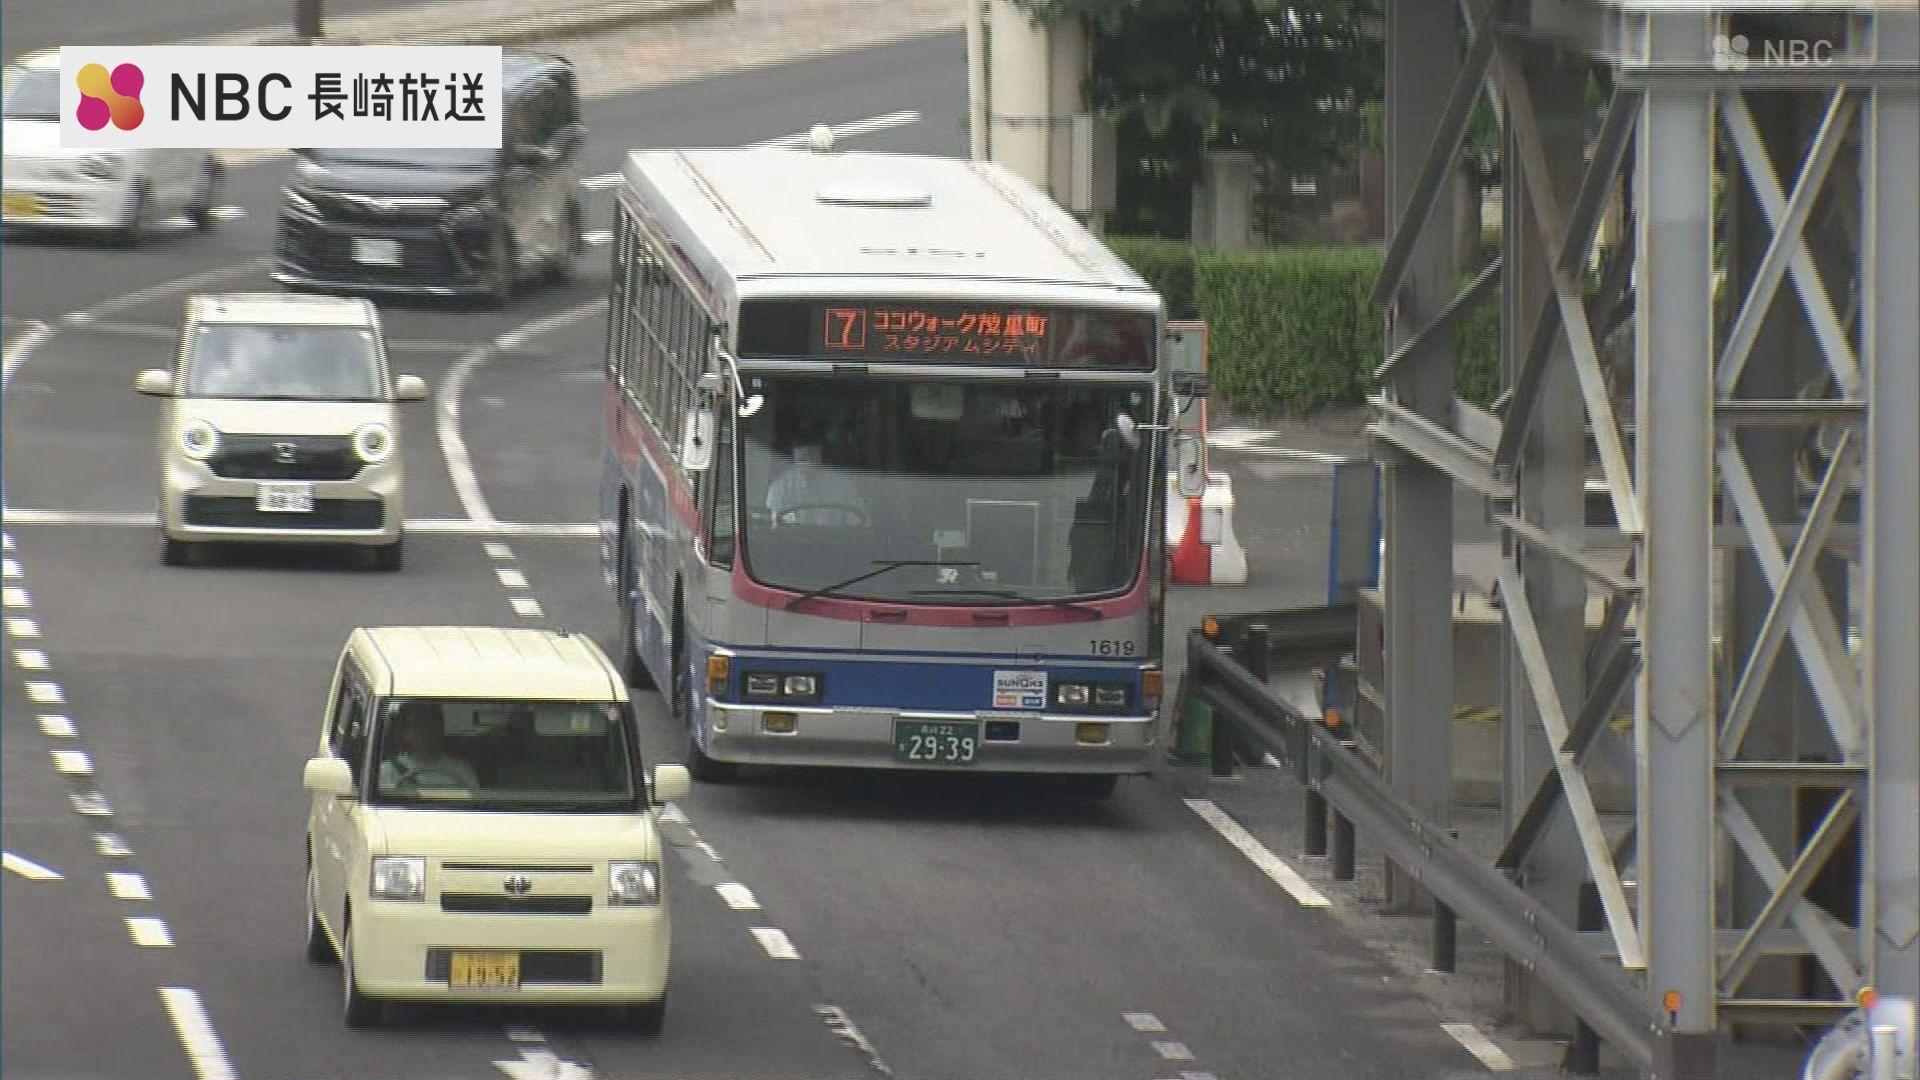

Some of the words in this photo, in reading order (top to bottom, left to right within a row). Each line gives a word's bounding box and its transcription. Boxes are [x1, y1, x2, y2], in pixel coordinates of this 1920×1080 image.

[836, 310, 858, 347] 7
[1089, 640, 1136, 656] 1619
[909, 735, 973, 760] 29-39
